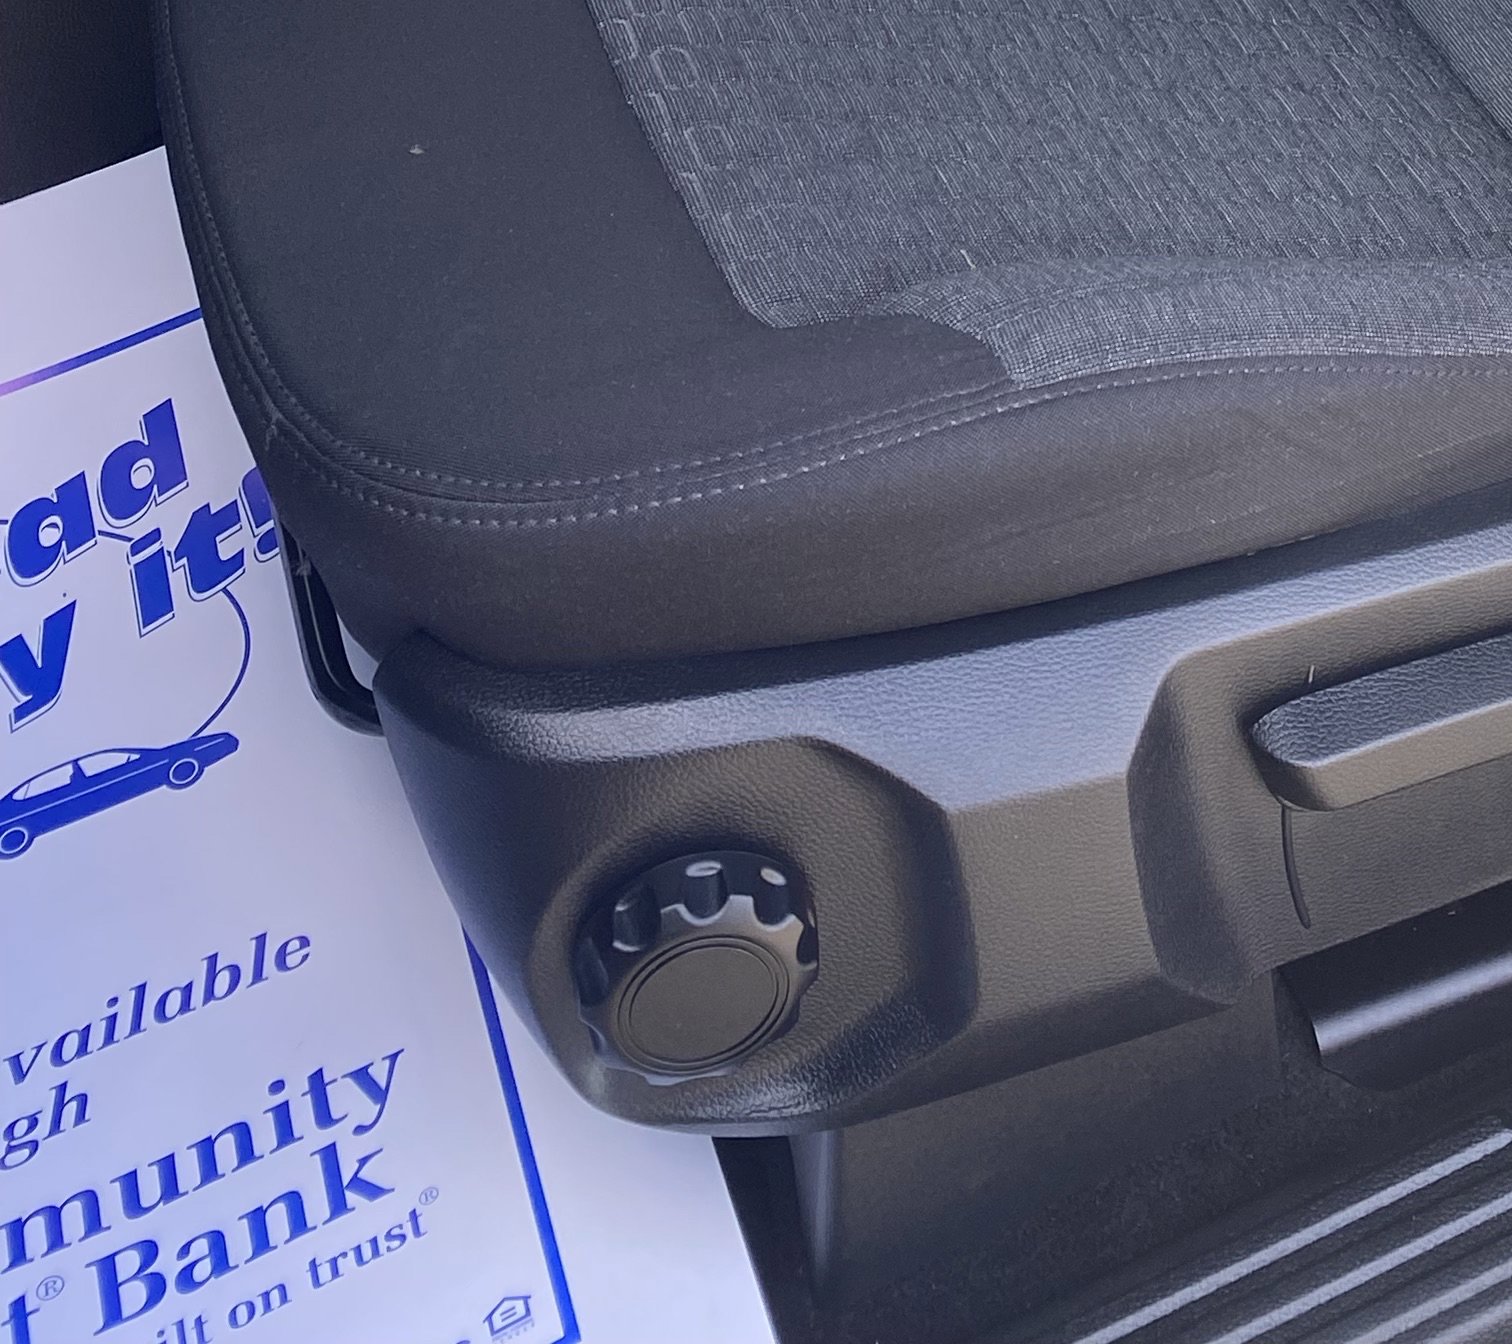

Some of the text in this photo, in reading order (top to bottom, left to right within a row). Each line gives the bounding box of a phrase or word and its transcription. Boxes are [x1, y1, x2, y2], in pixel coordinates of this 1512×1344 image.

[2, 930, 312, 1086] vailable
[0, 1079, 91, 1172] gh
[0, 1047, 406, 1275] munity
[84, 1140, 396, 1337] Bank
[227, 1282, 292, 1330] on
